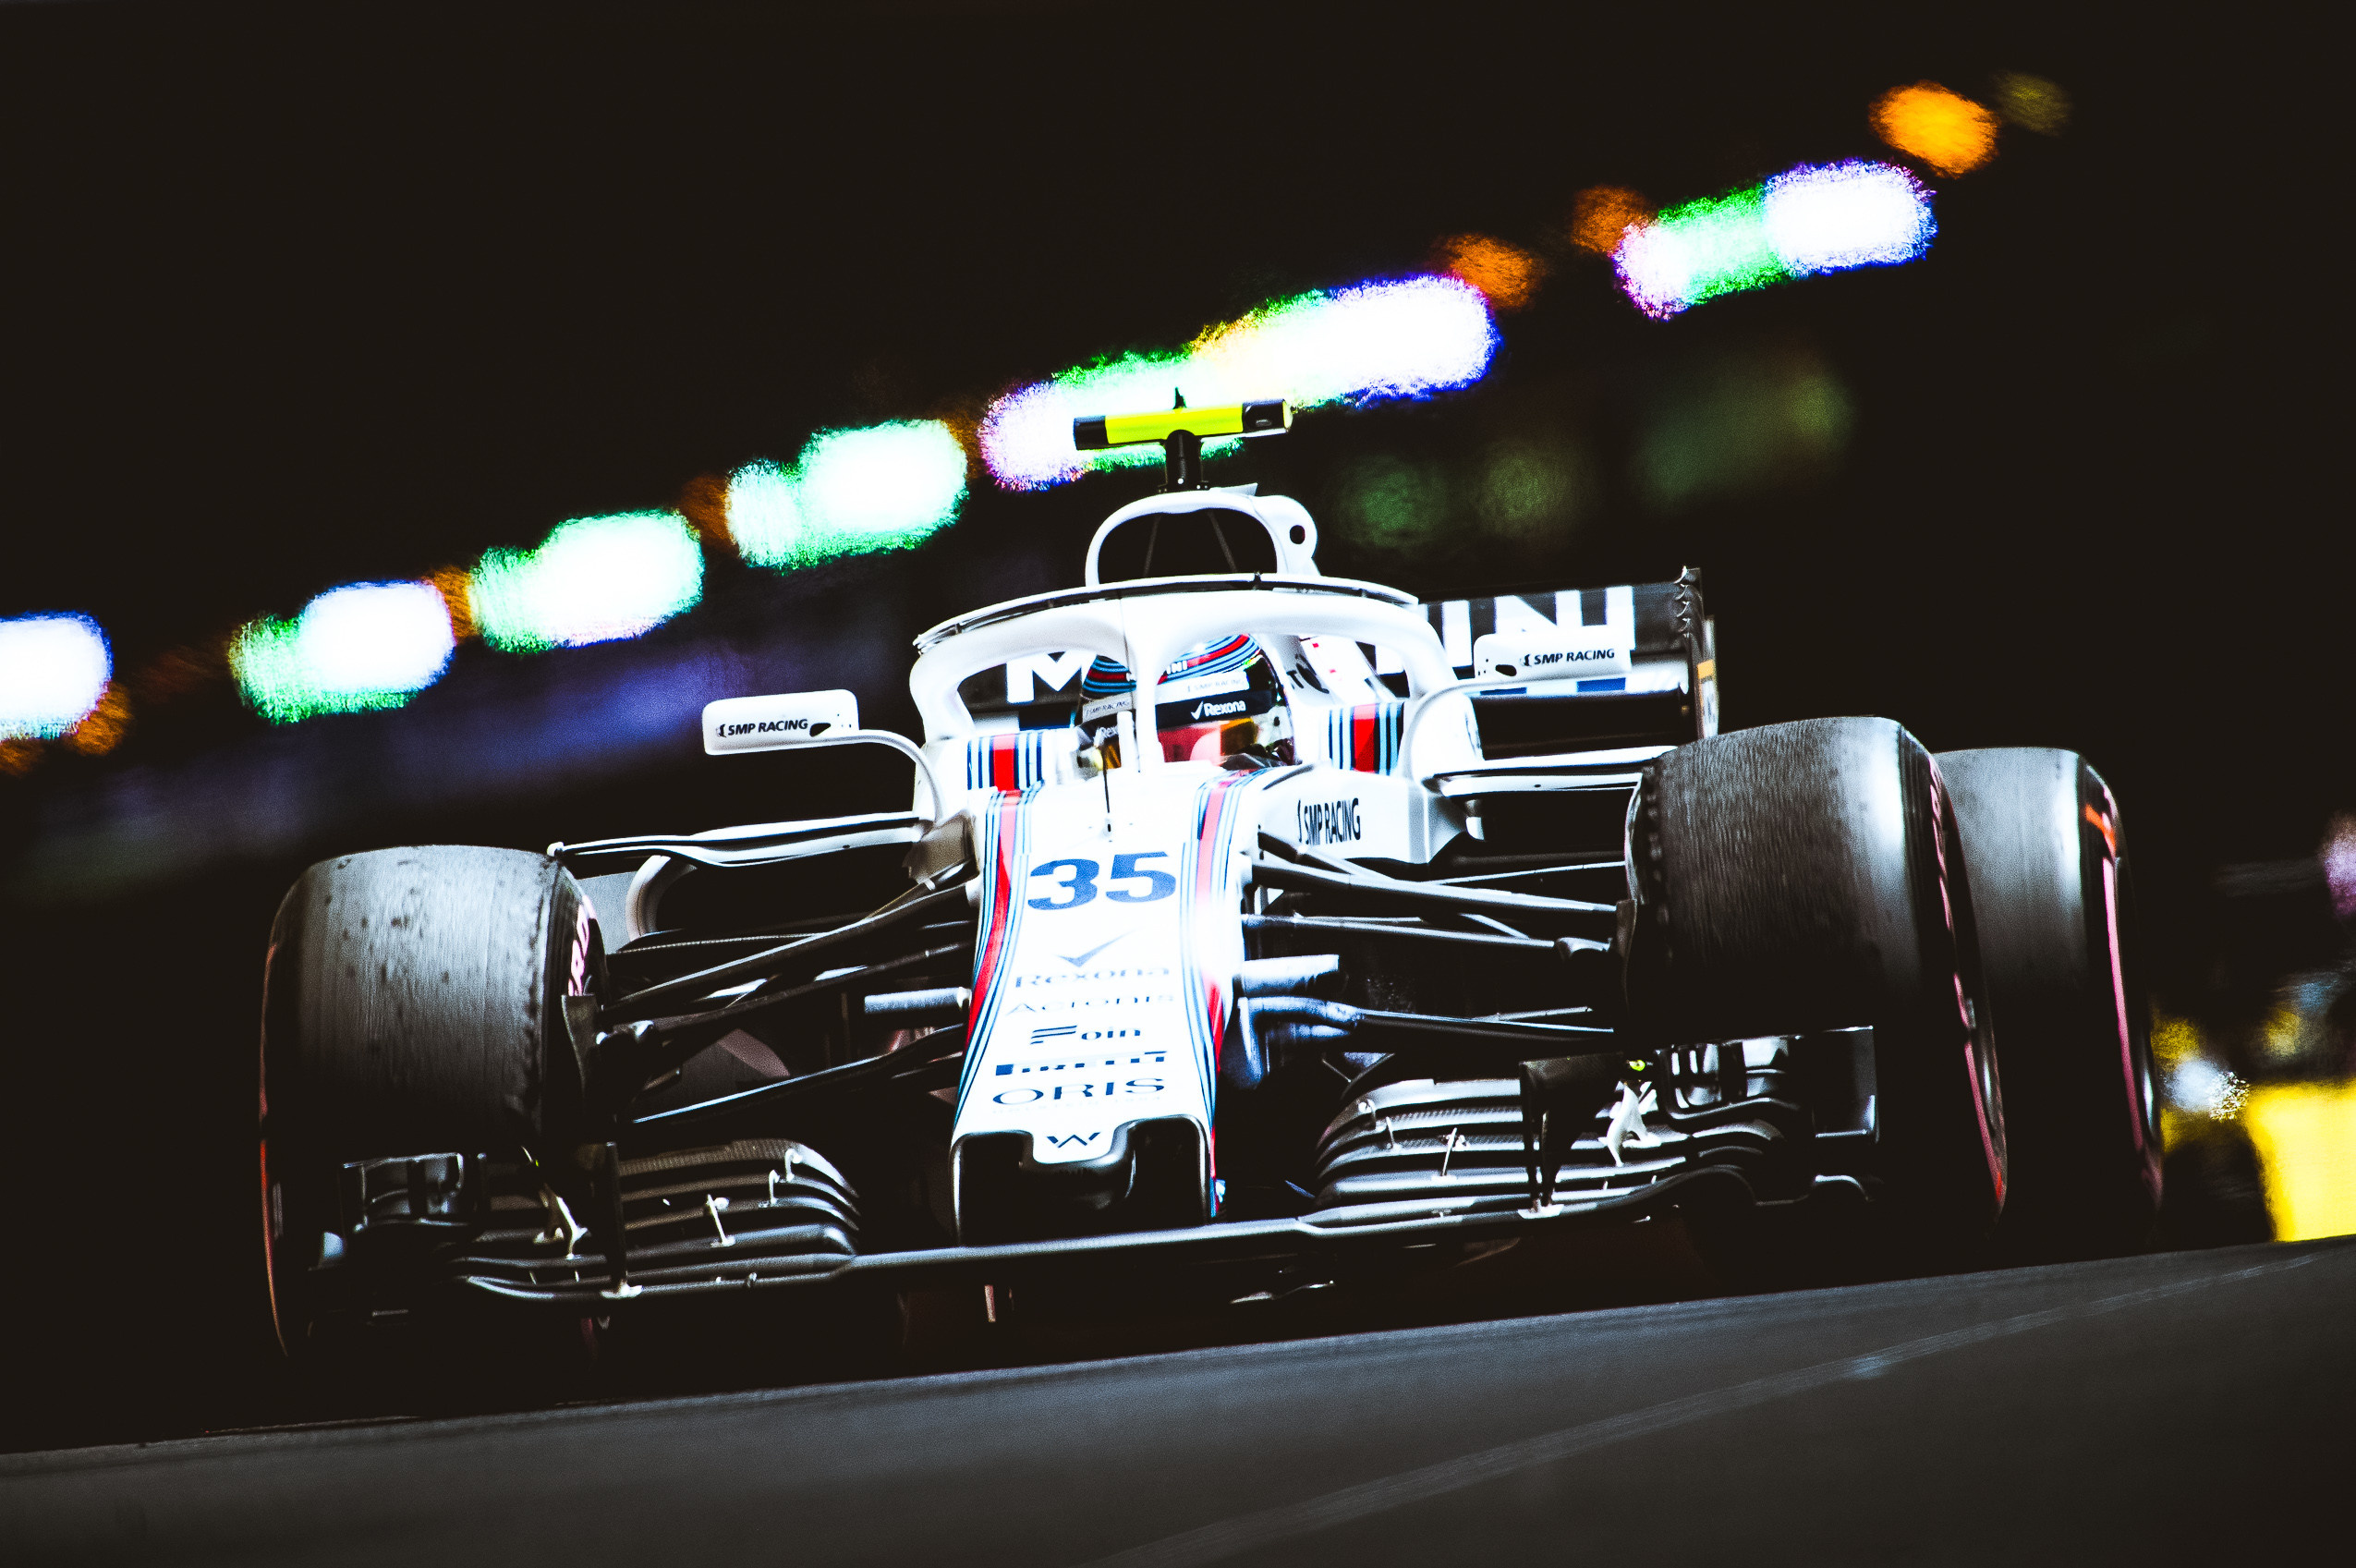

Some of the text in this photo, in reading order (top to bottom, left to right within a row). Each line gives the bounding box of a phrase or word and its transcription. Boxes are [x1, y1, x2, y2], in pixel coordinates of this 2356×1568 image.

[1534, 648, 1615, 665] SMP RACING
[1204, 700, 1246, 717] Rexona
[728, 719, 808, 736] SMP RACING
[1304, 797, 1361, 845] SMP RACING
[1027, 851, 1177, 910] 35
[991, 1077, 1165, 1105] ORIS
